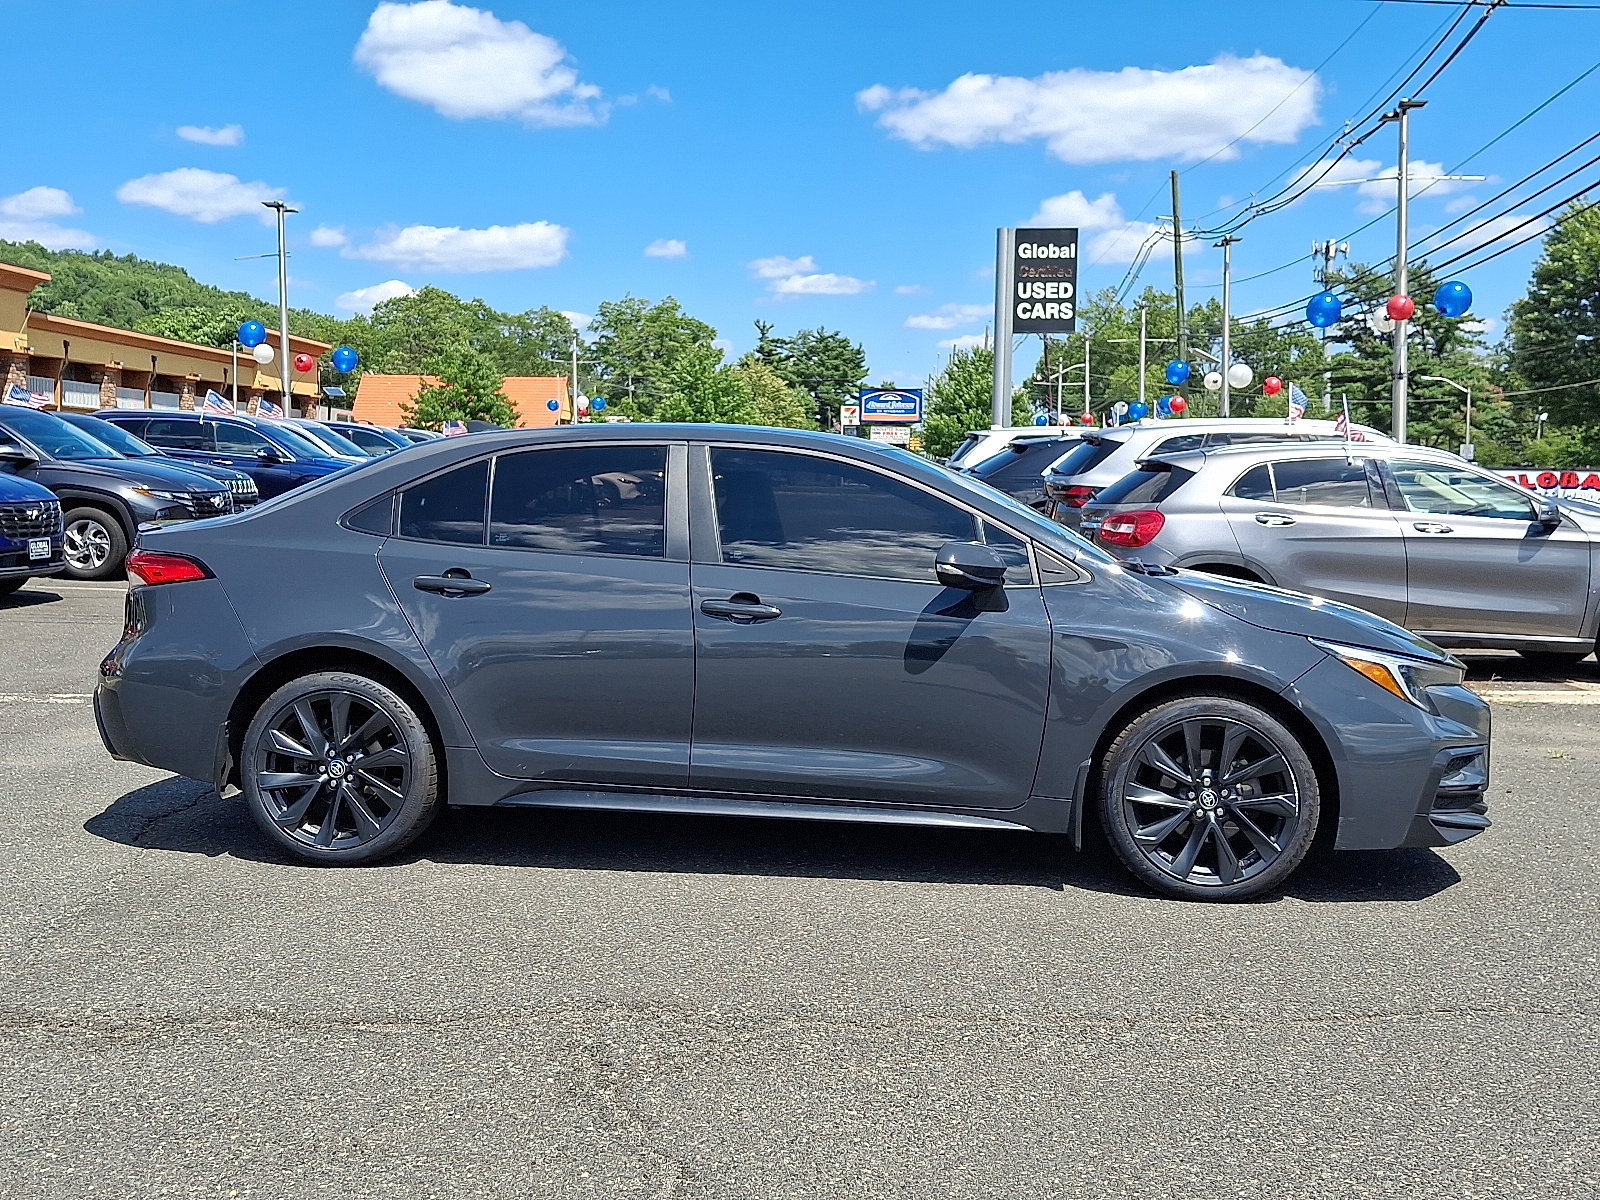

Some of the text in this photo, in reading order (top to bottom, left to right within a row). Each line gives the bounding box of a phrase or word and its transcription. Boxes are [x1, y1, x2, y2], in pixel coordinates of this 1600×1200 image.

[1018, 243, 1076, 259] Global
[1017, 282, 1074, 299] USED
[1016, 302, 1074, 320] CARS
[1504, 471, 1600, 491] LOBA
[330, 675, 417, 732] CONTINENTAL
